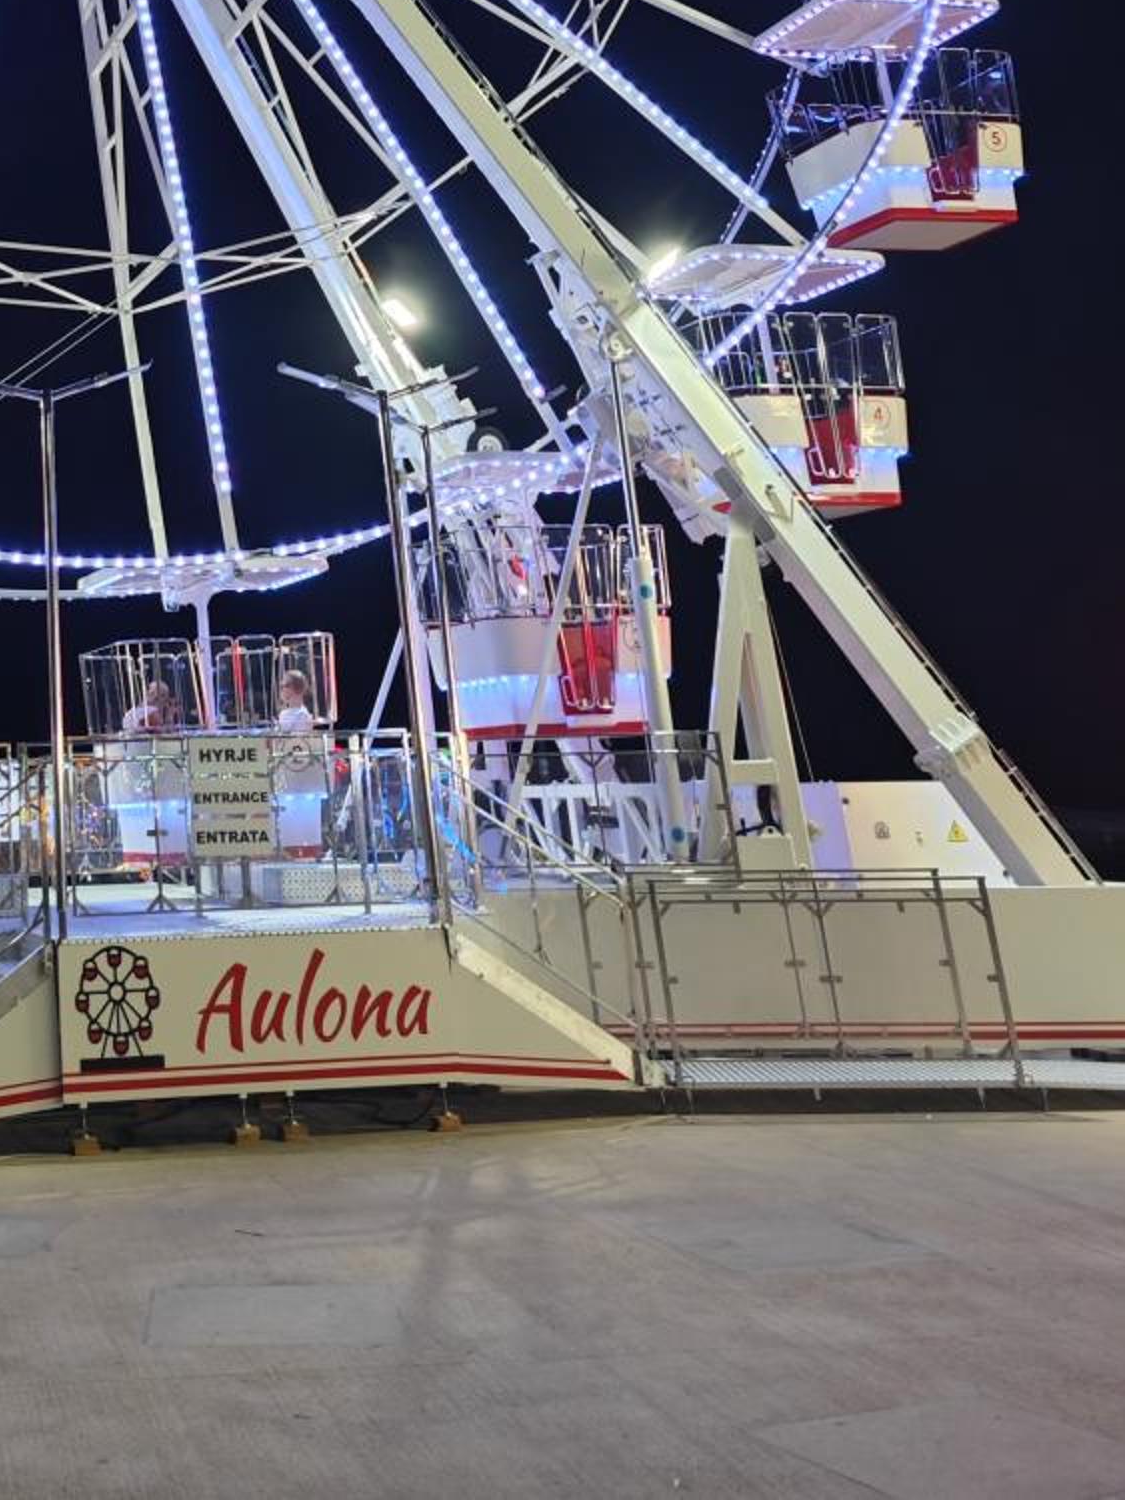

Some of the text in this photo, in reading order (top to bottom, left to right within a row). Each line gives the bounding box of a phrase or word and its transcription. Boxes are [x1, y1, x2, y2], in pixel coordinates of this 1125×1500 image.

[991, 130, 1002, 145] 5
[873, 406, 884, 421] 4
[198, 747, 258, 763] HYRJE
[194, 791, 269, 804] ENTRANCE
[196, 830, 270, 845] ENTRATA
[196, 947, 432, 1055] Aulona
